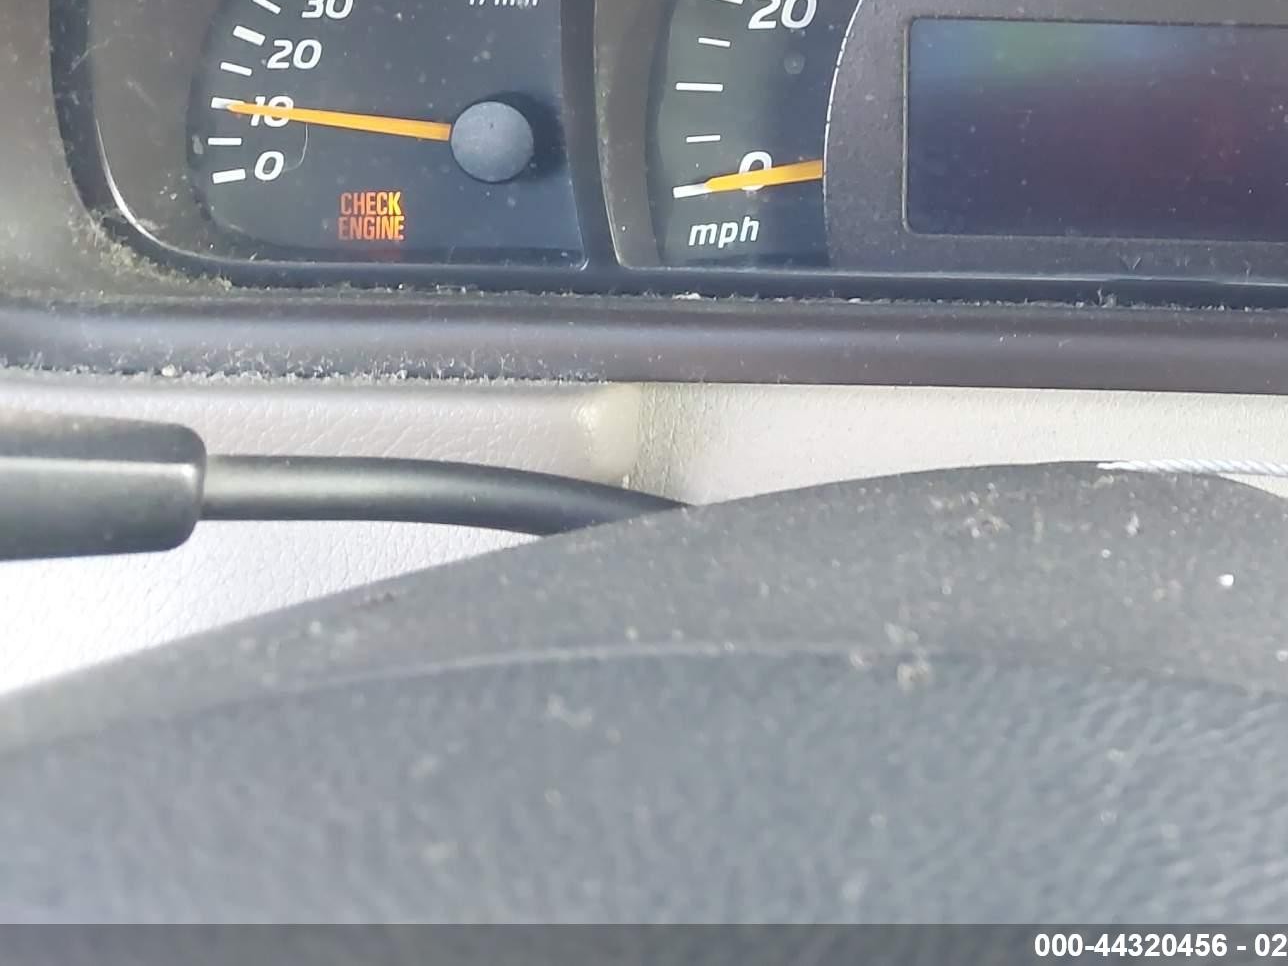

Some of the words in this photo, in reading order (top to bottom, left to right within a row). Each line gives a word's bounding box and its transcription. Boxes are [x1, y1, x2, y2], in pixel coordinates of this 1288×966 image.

[266, 39, 322, 70] 20
[250, 96, 294, 127] 10
[254, 151, 284, 181] 0
[738, 151, 773, 193] 0
[341, 190, 401, 216] CHECK
[339, 215, 404, 241] ENGINE
[688, 216, 760, 248] mph
